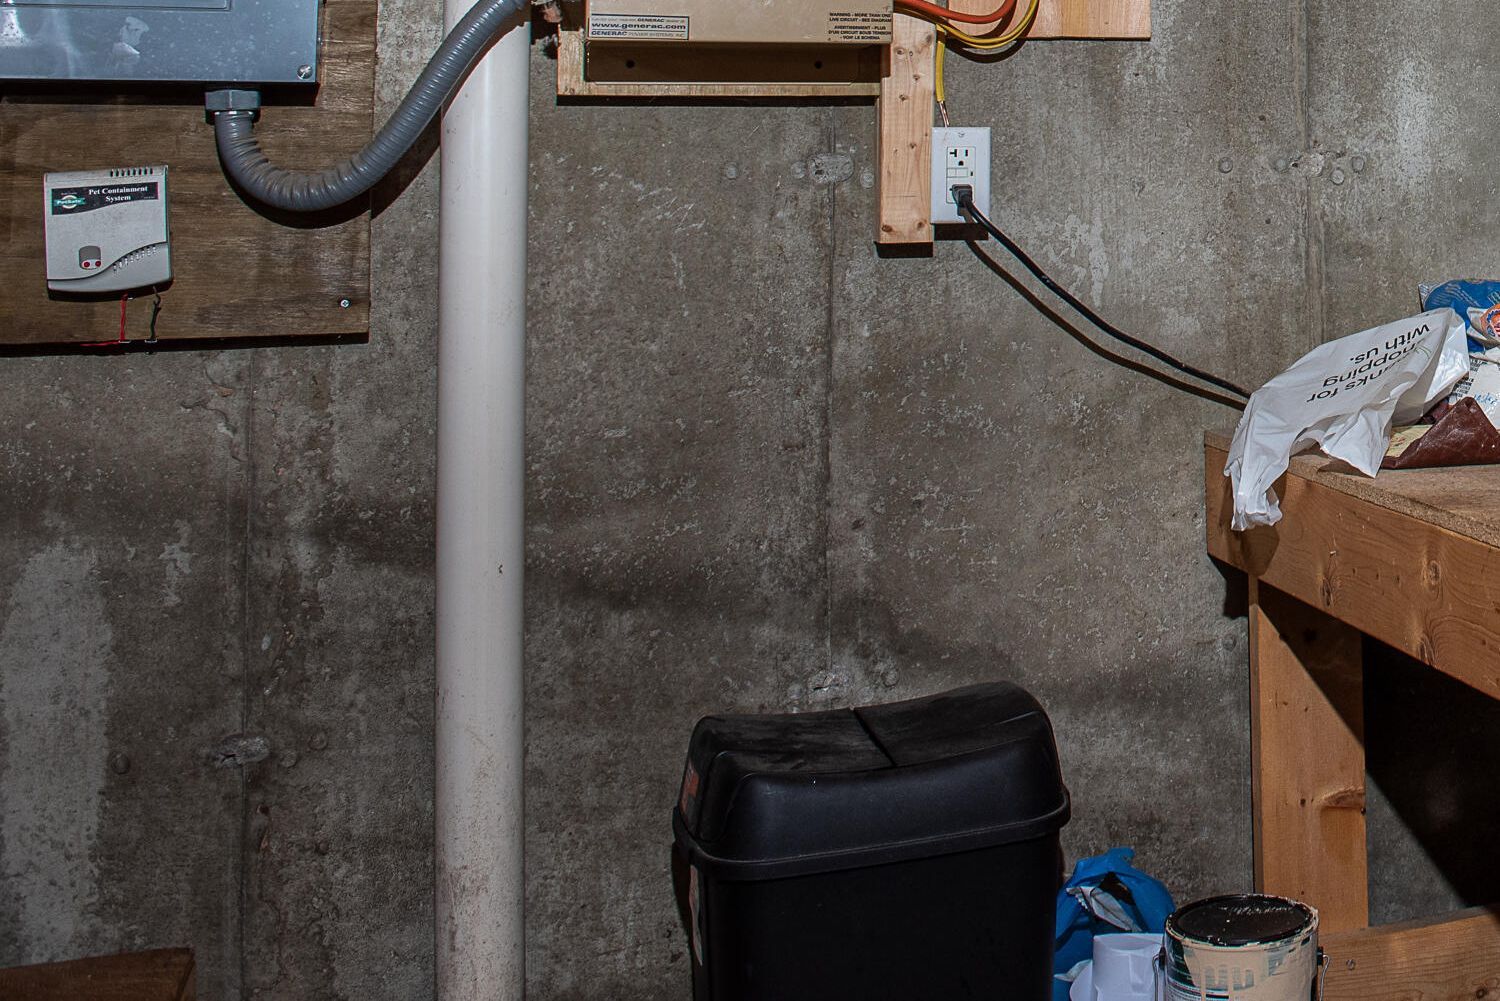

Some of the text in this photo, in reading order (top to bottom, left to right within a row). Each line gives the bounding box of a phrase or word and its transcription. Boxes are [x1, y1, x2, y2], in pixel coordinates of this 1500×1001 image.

[591, 22, 686, 30] www.generac.com
[102, 186, 148, 194] Containment
[105, 195, 131, 203] System
[1350, 323, 1430, 365] with us.
[1322, 342, 1416, 388] hopping
[1306, 387, 1339, 403] for
